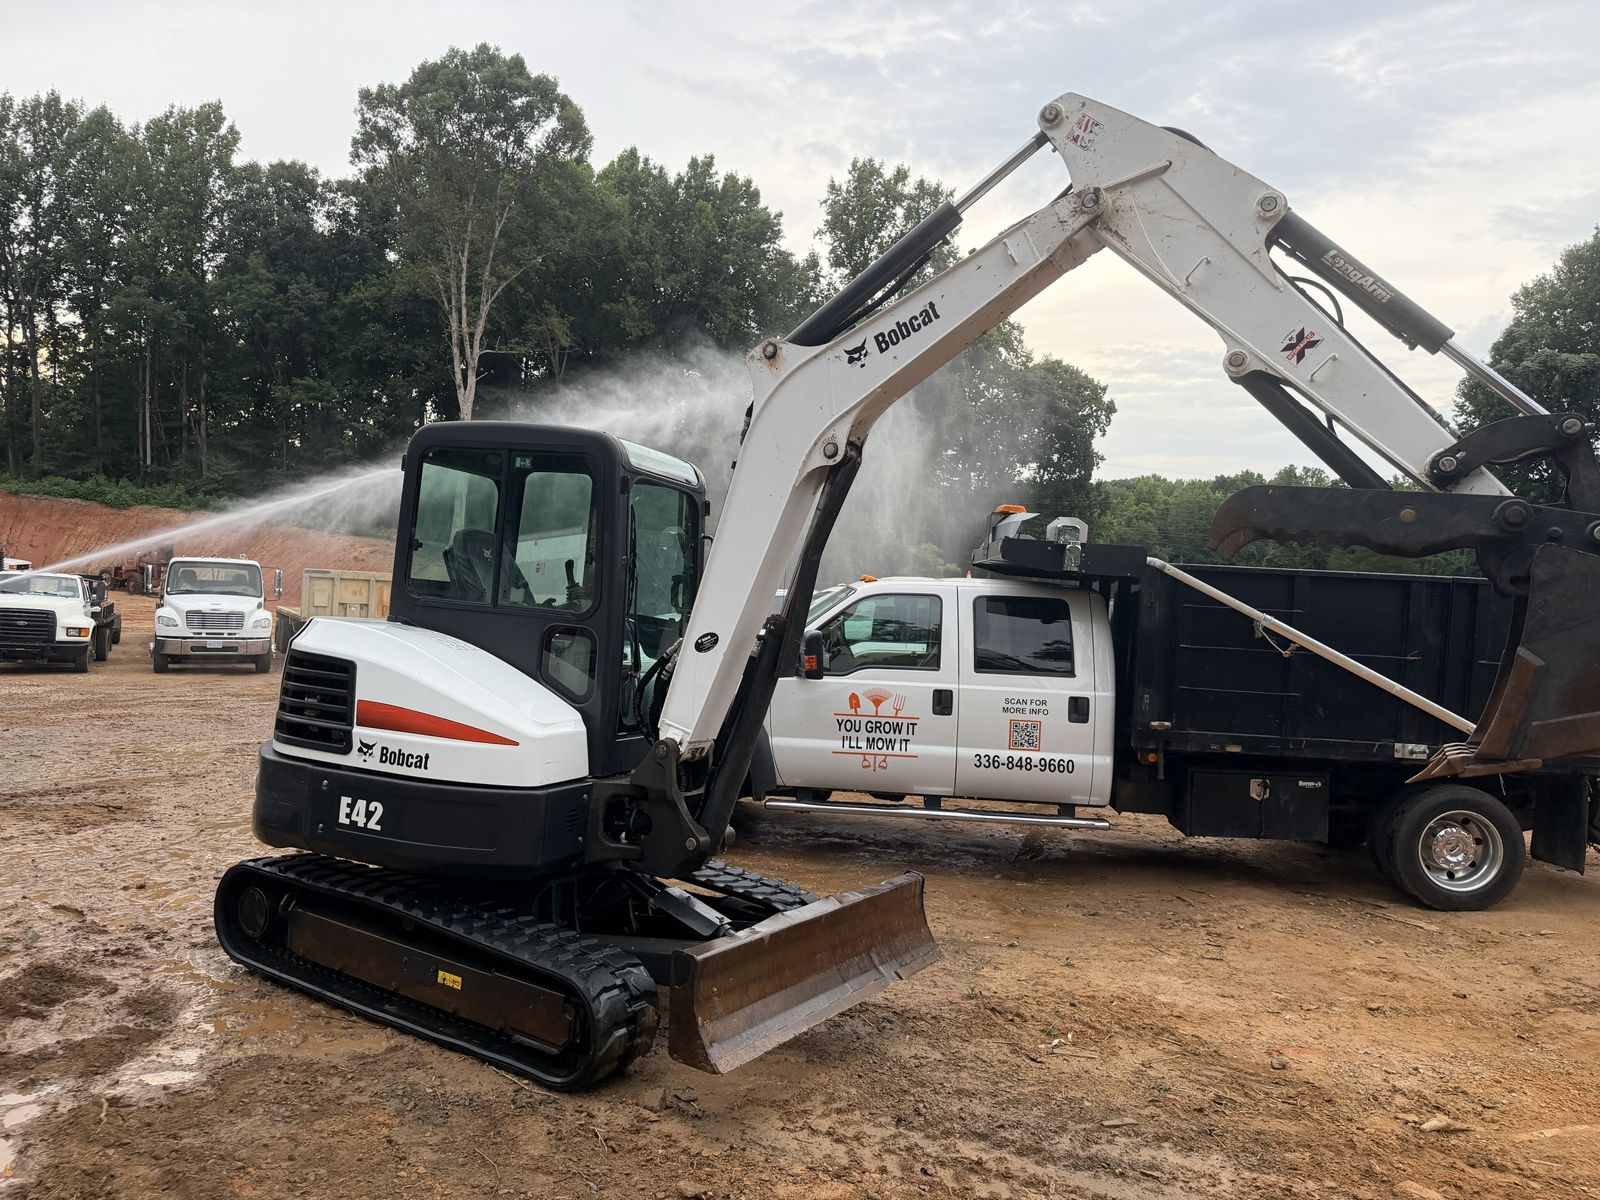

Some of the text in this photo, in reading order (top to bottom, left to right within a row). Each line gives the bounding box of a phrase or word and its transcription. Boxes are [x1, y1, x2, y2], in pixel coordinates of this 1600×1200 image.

[873, 301, 941, 354] Bobcat
[1002, 706, 1049, 716] MORE INFO
[1004, 697, 1048, 707] SCAN FOR
[836, 718, 918, 736] YOU GROW IT
[841, 735, 911, 752] I'LL MOW IT
[379, 746, 430, 770] Bobcat
[974, 753, 1075, 774] 336-848-9660
[338, 795, 384, 831] E42
